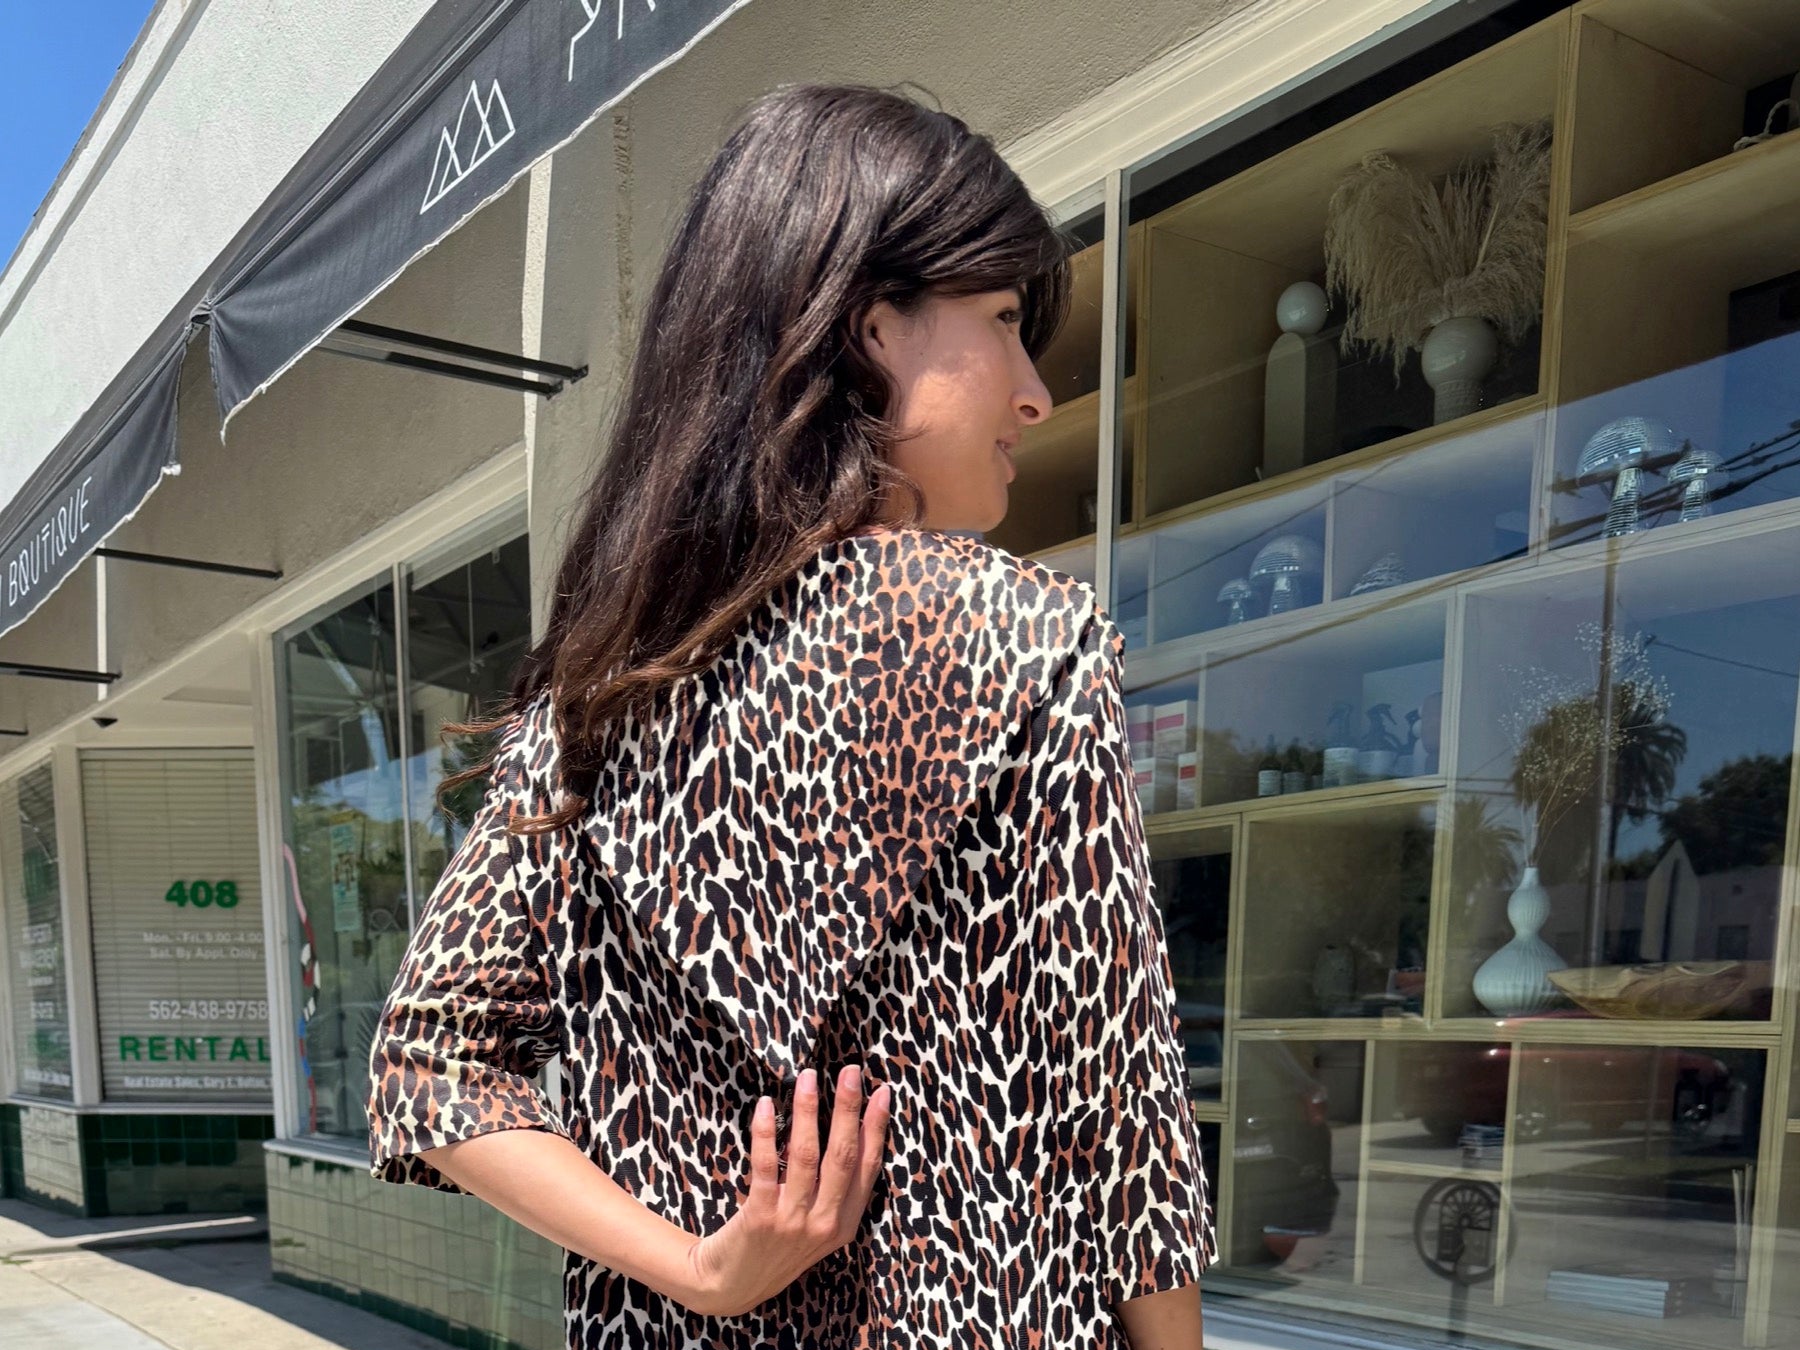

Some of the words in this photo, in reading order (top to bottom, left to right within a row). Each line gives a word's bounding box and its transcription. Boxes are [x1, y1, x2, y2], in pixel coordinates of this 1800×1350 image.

[9, 476, 92, 607] BOUTIQUE
[164, 880, 239, 909] 408
[176, 946, 191, 960] By
[230, 946, 258, 960] Only
[149, 1000, 269, 1019] 562-438-9758
[119, 1036, 271, 1061] RENTAL
